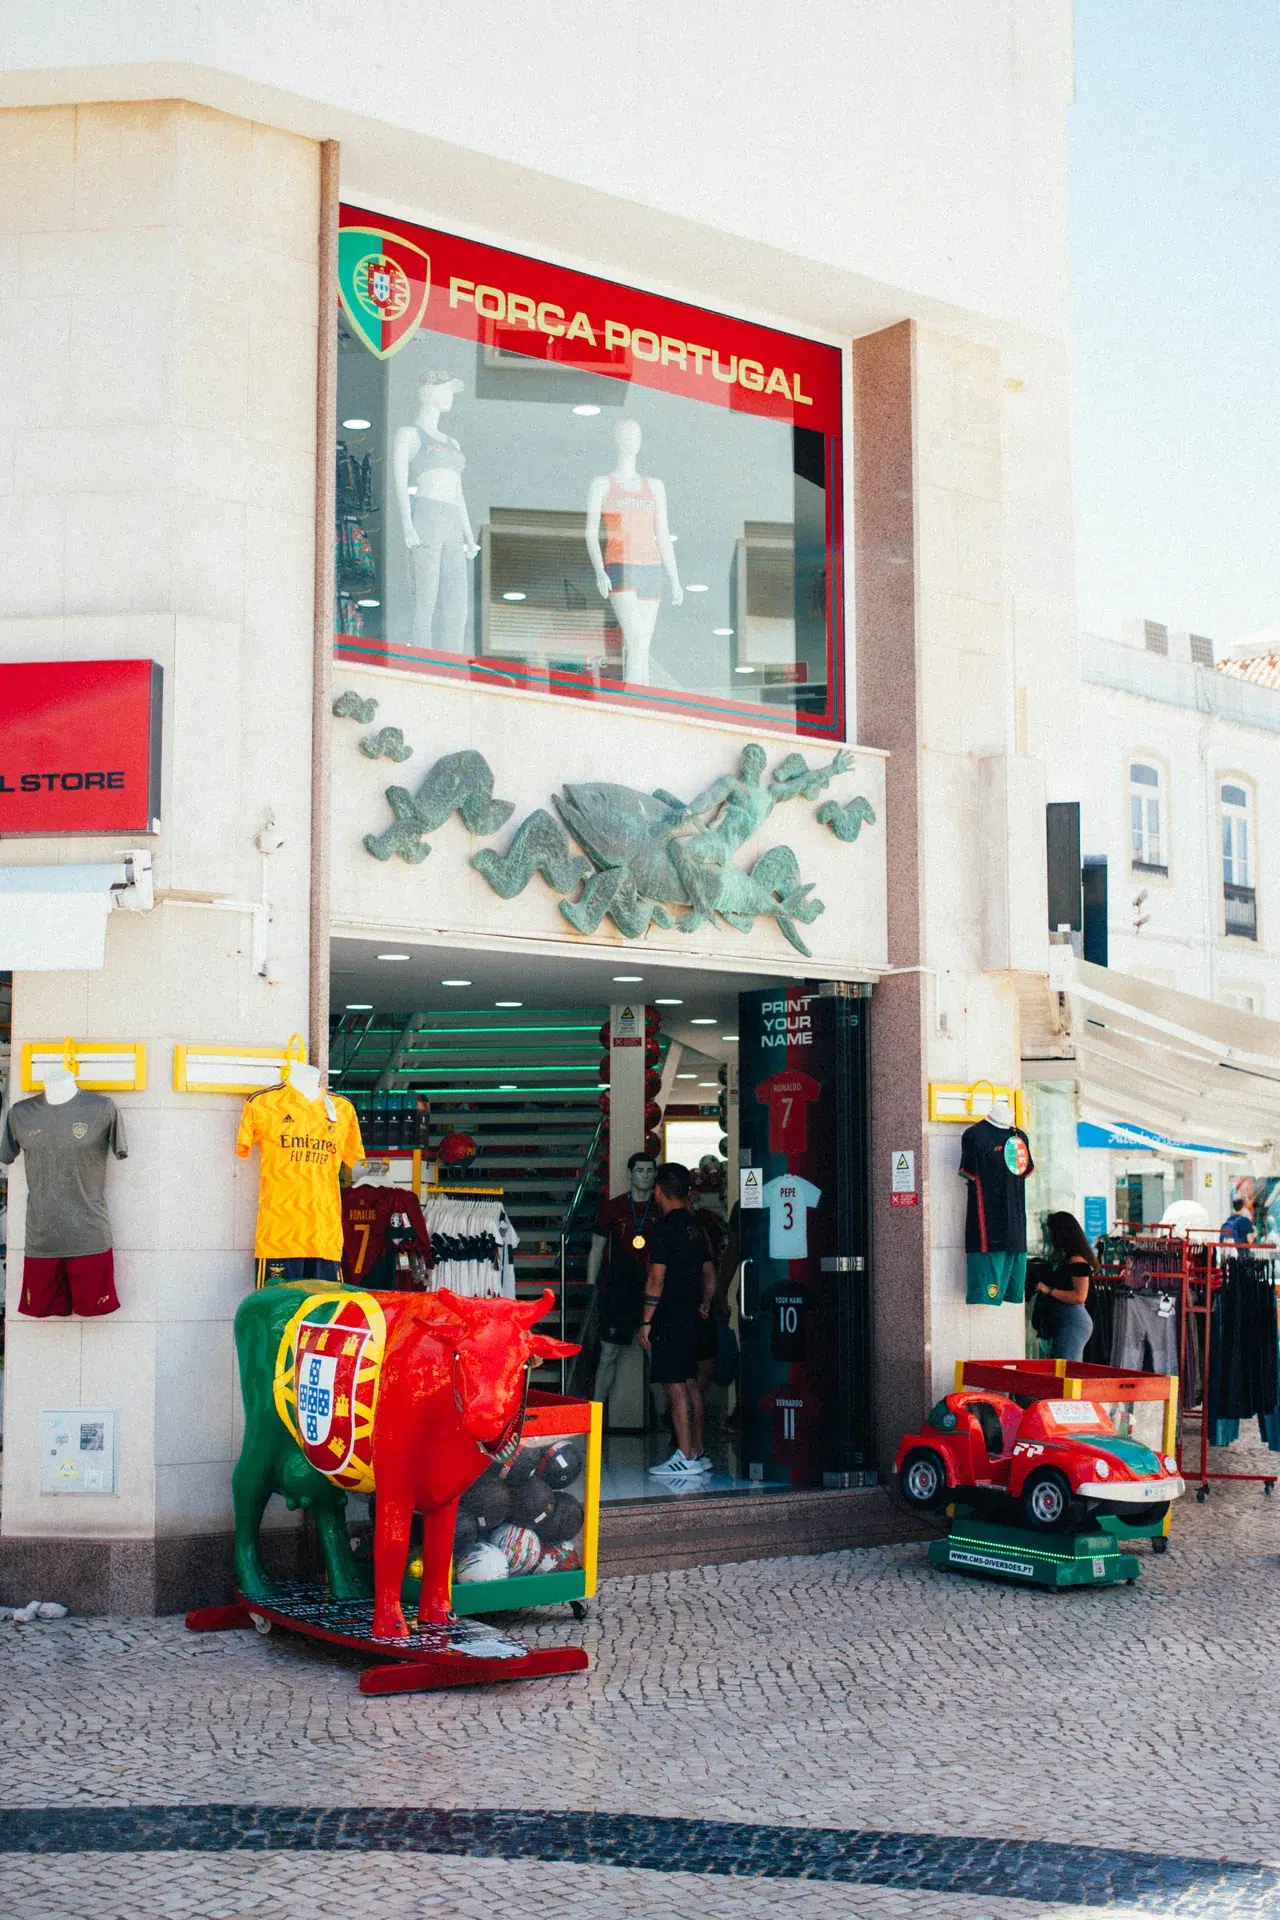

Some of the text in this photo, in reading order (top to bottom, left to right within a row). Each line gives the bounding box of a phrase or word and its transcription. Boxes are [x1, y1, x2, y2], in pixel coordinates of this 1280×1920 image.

[449, 275, 813, 406] FORÇA PORTUGAL
[20, 771, 126, 792] STORE
[761, 998, 812, 1015] PRINT
[763, 1015, 812, 1032] YOUR
[761, 1032, 813, 1048] NAME
[781, 1097, 794, 1129] 7
[305, 1150, 330, 1165] BTTER
[780, 1187, 796, 1198] PEPE
[783, 1202, 794, 1231] 3
[354, 1223, 371, 1274] 7
[780, 1305, 798, 1334] 10
[783, 1408, 796, 1440] 11
